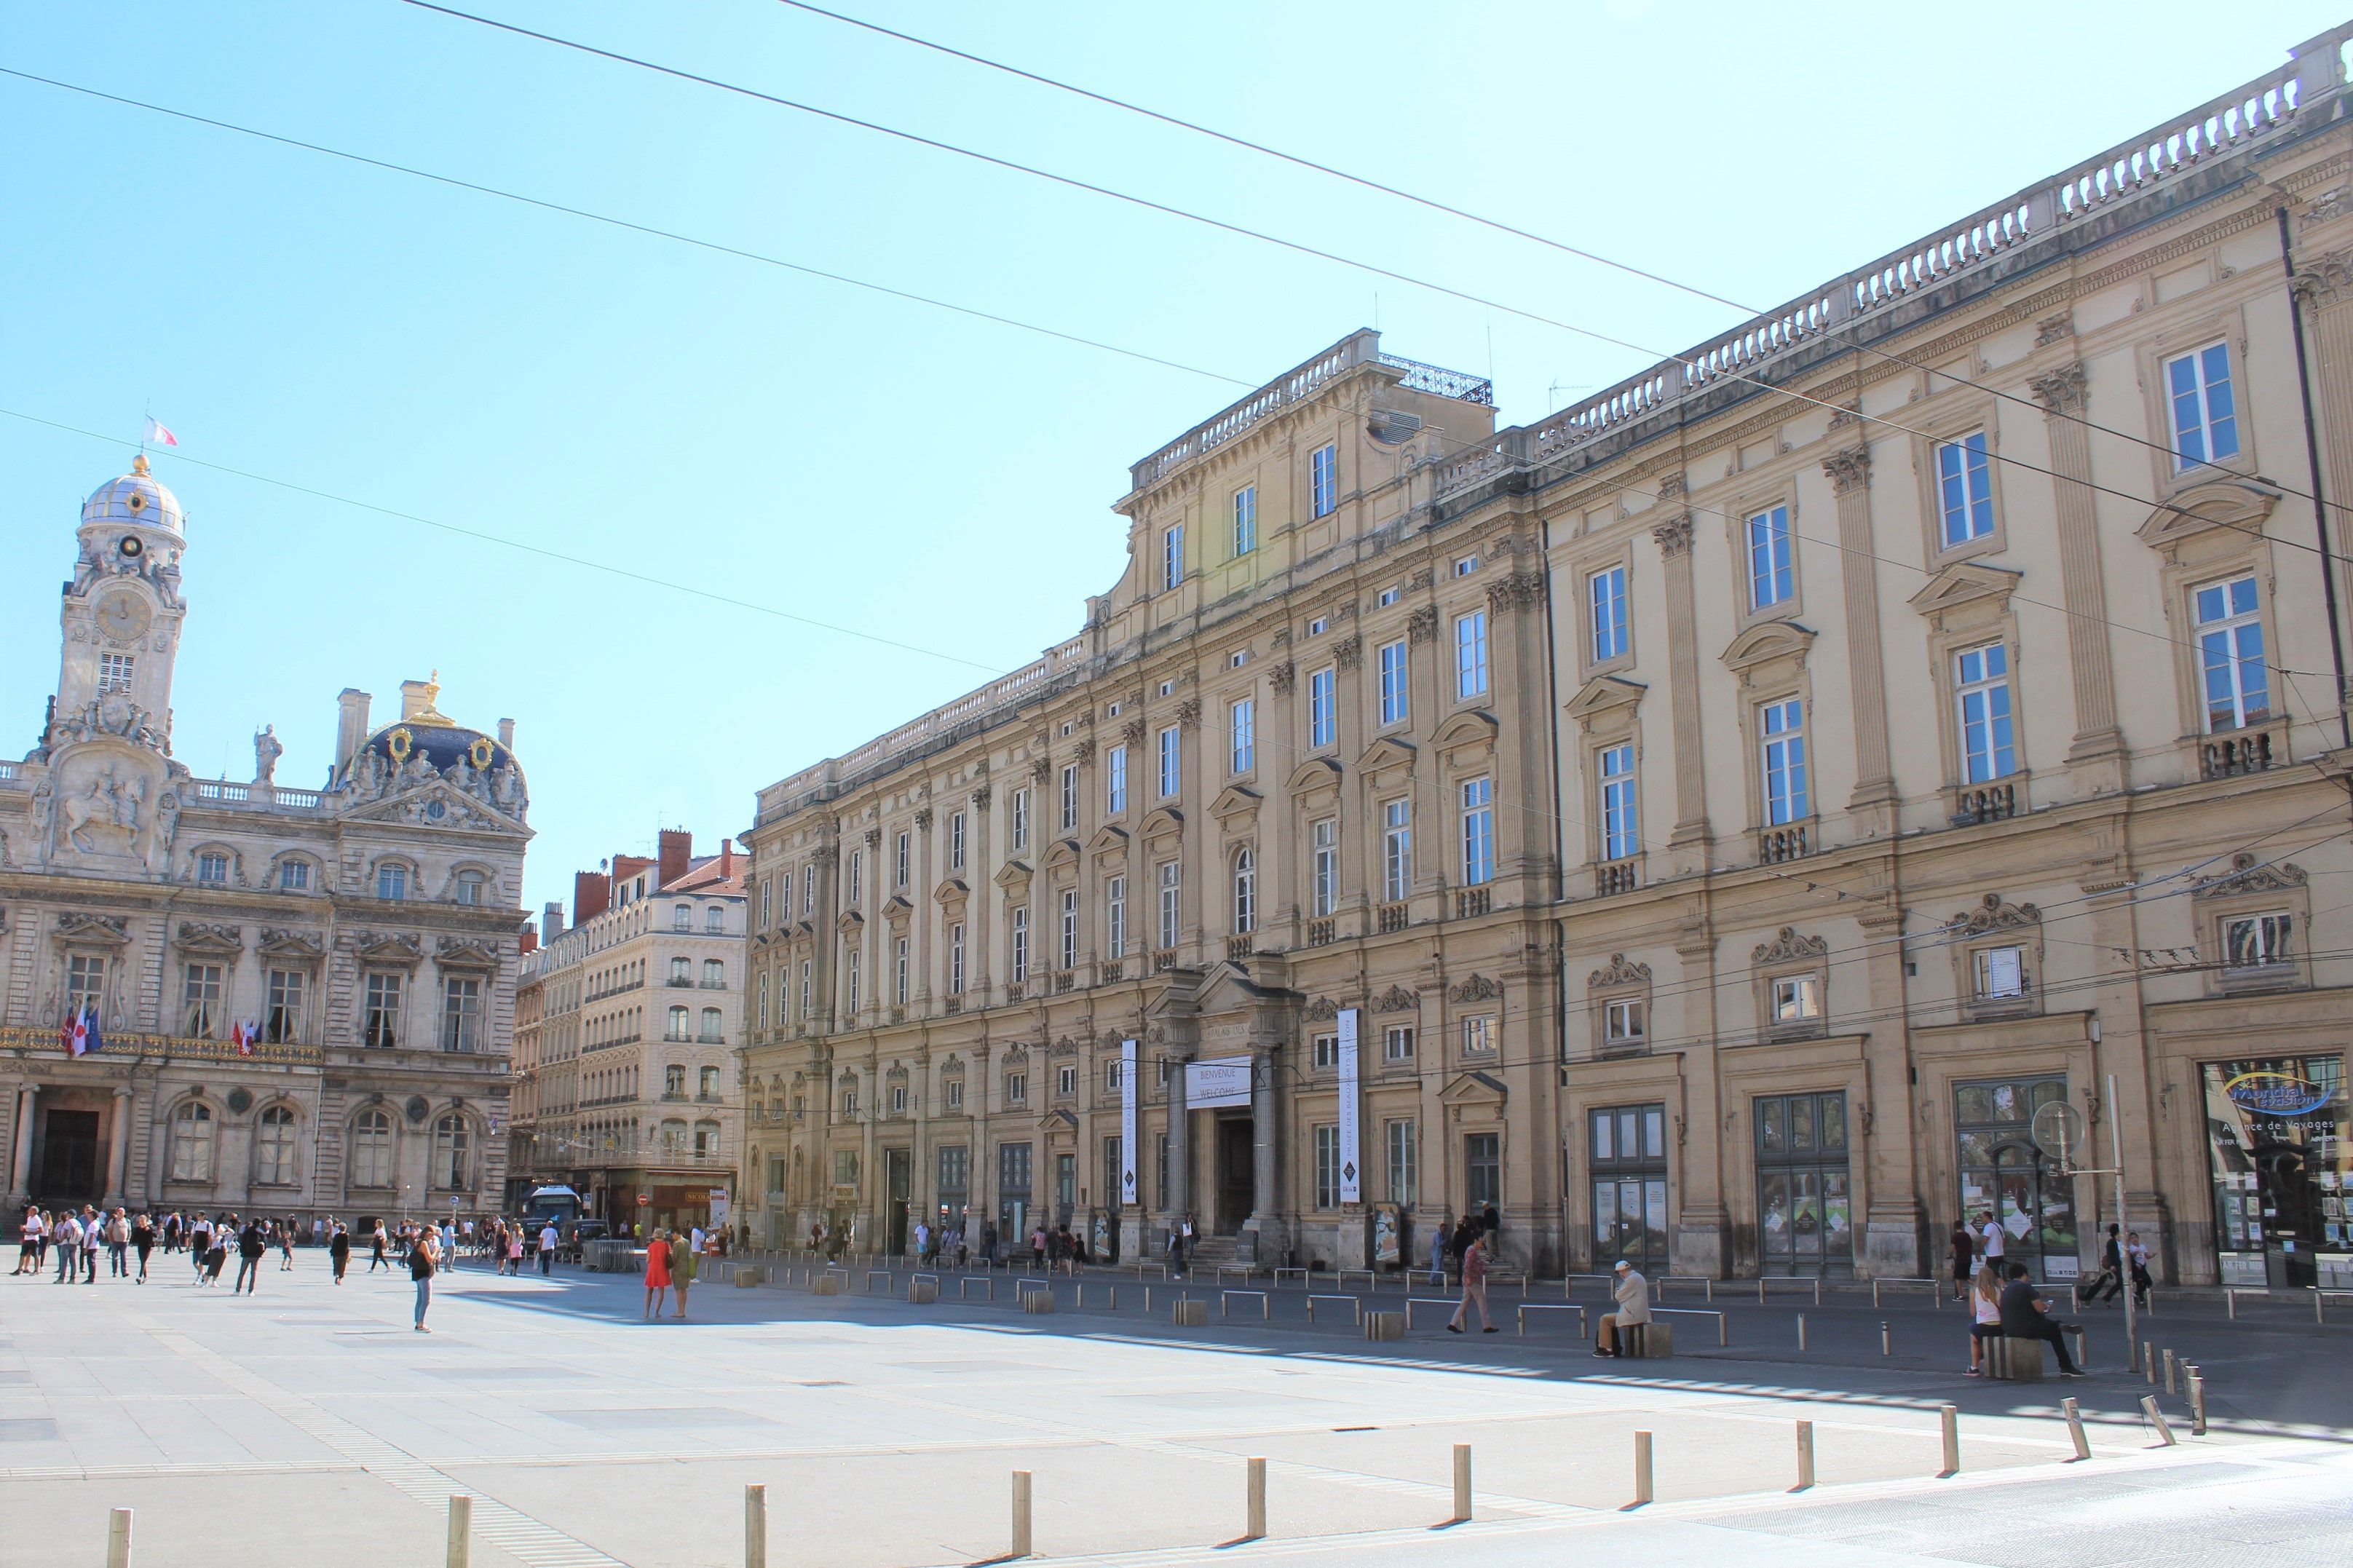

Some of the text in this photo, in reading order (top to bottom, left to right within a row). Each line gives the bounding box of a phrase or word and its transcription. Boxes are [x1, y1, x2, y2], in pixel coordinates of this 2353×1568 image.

[1201, 1068, 1235, 1080] BIENVENUE
[1201, 1087, 1235, 1098] WELCOME
[2230, 1084, 2306, 1101] Mondial
[2223, 1120, 2334, 1133] Agence de Voyages
[2223, 1261, 2234, 1270] AIR
[2235, 1262, 2247, 1270] FER
